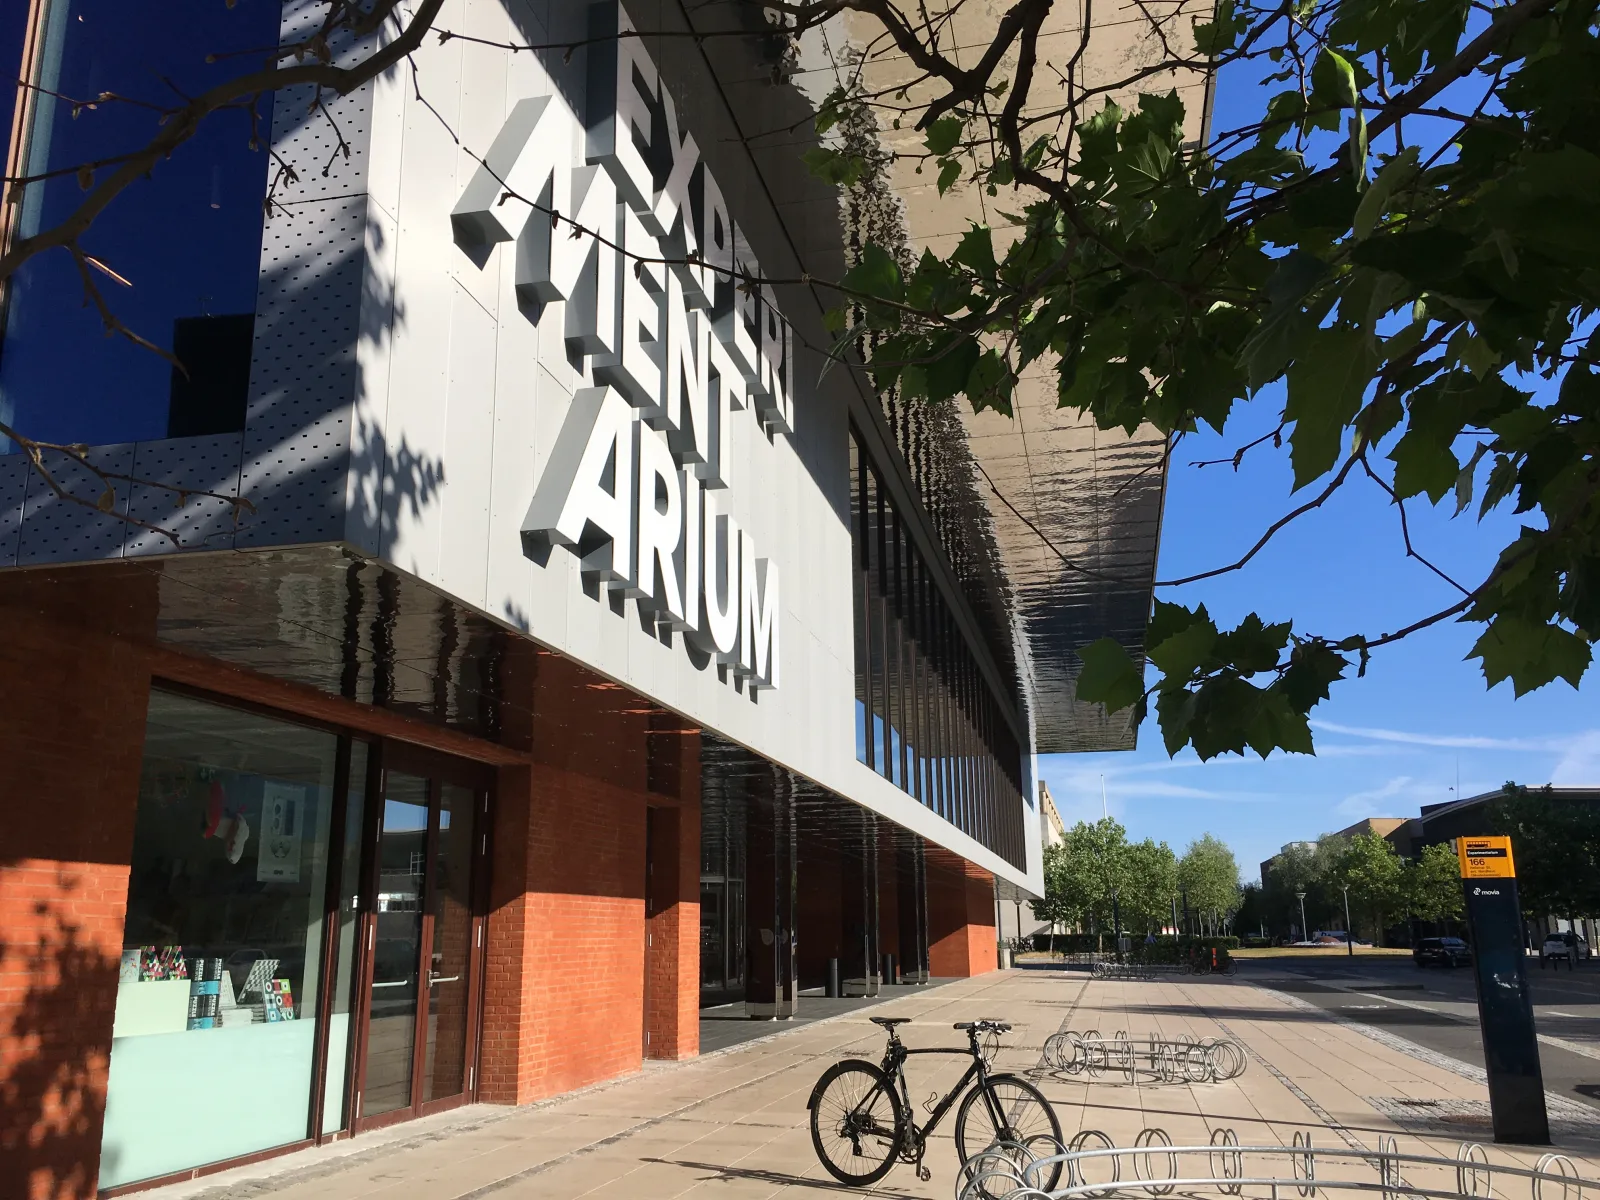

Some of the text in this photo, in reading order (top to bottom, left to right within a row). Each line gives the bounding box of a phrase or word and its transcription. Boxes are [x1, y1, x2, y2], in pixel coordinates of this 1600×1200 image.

[486, 95, 747, 489] MENT
[614, 0, 793, 434] EXPERI
[554, 384, 779, 690] ARIUM
[1469, 858, 1485, 866] 166
